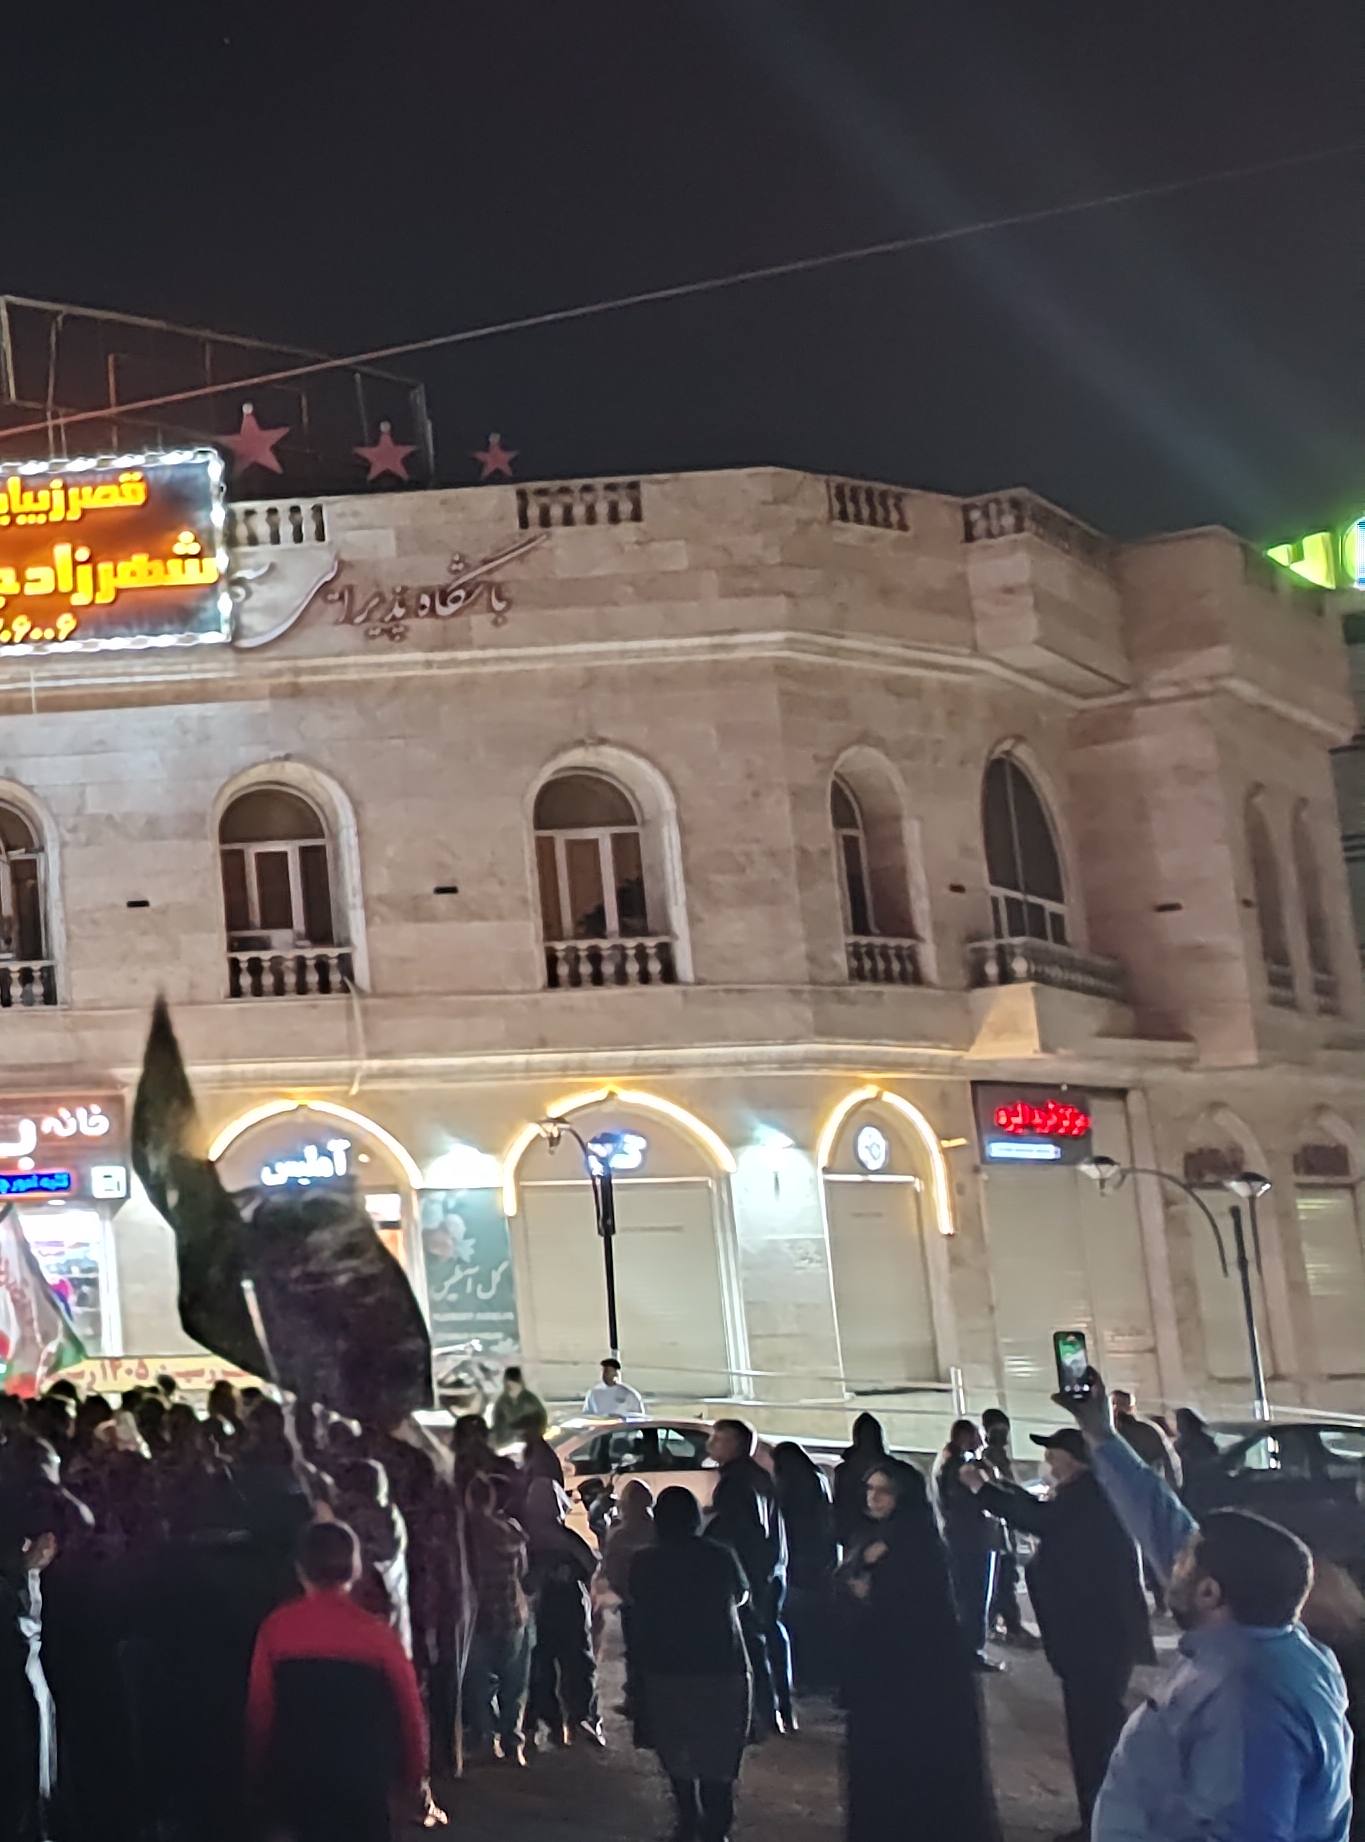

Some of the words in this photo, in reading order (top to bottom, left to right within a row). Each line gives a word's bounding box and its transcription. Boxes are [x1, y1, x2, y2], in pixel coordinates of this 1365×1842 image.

[66, 472, 147, 522] قصر
[24, 530, 220, 606] شهرزاد
[40, 1103, 110, 1137] خانه
